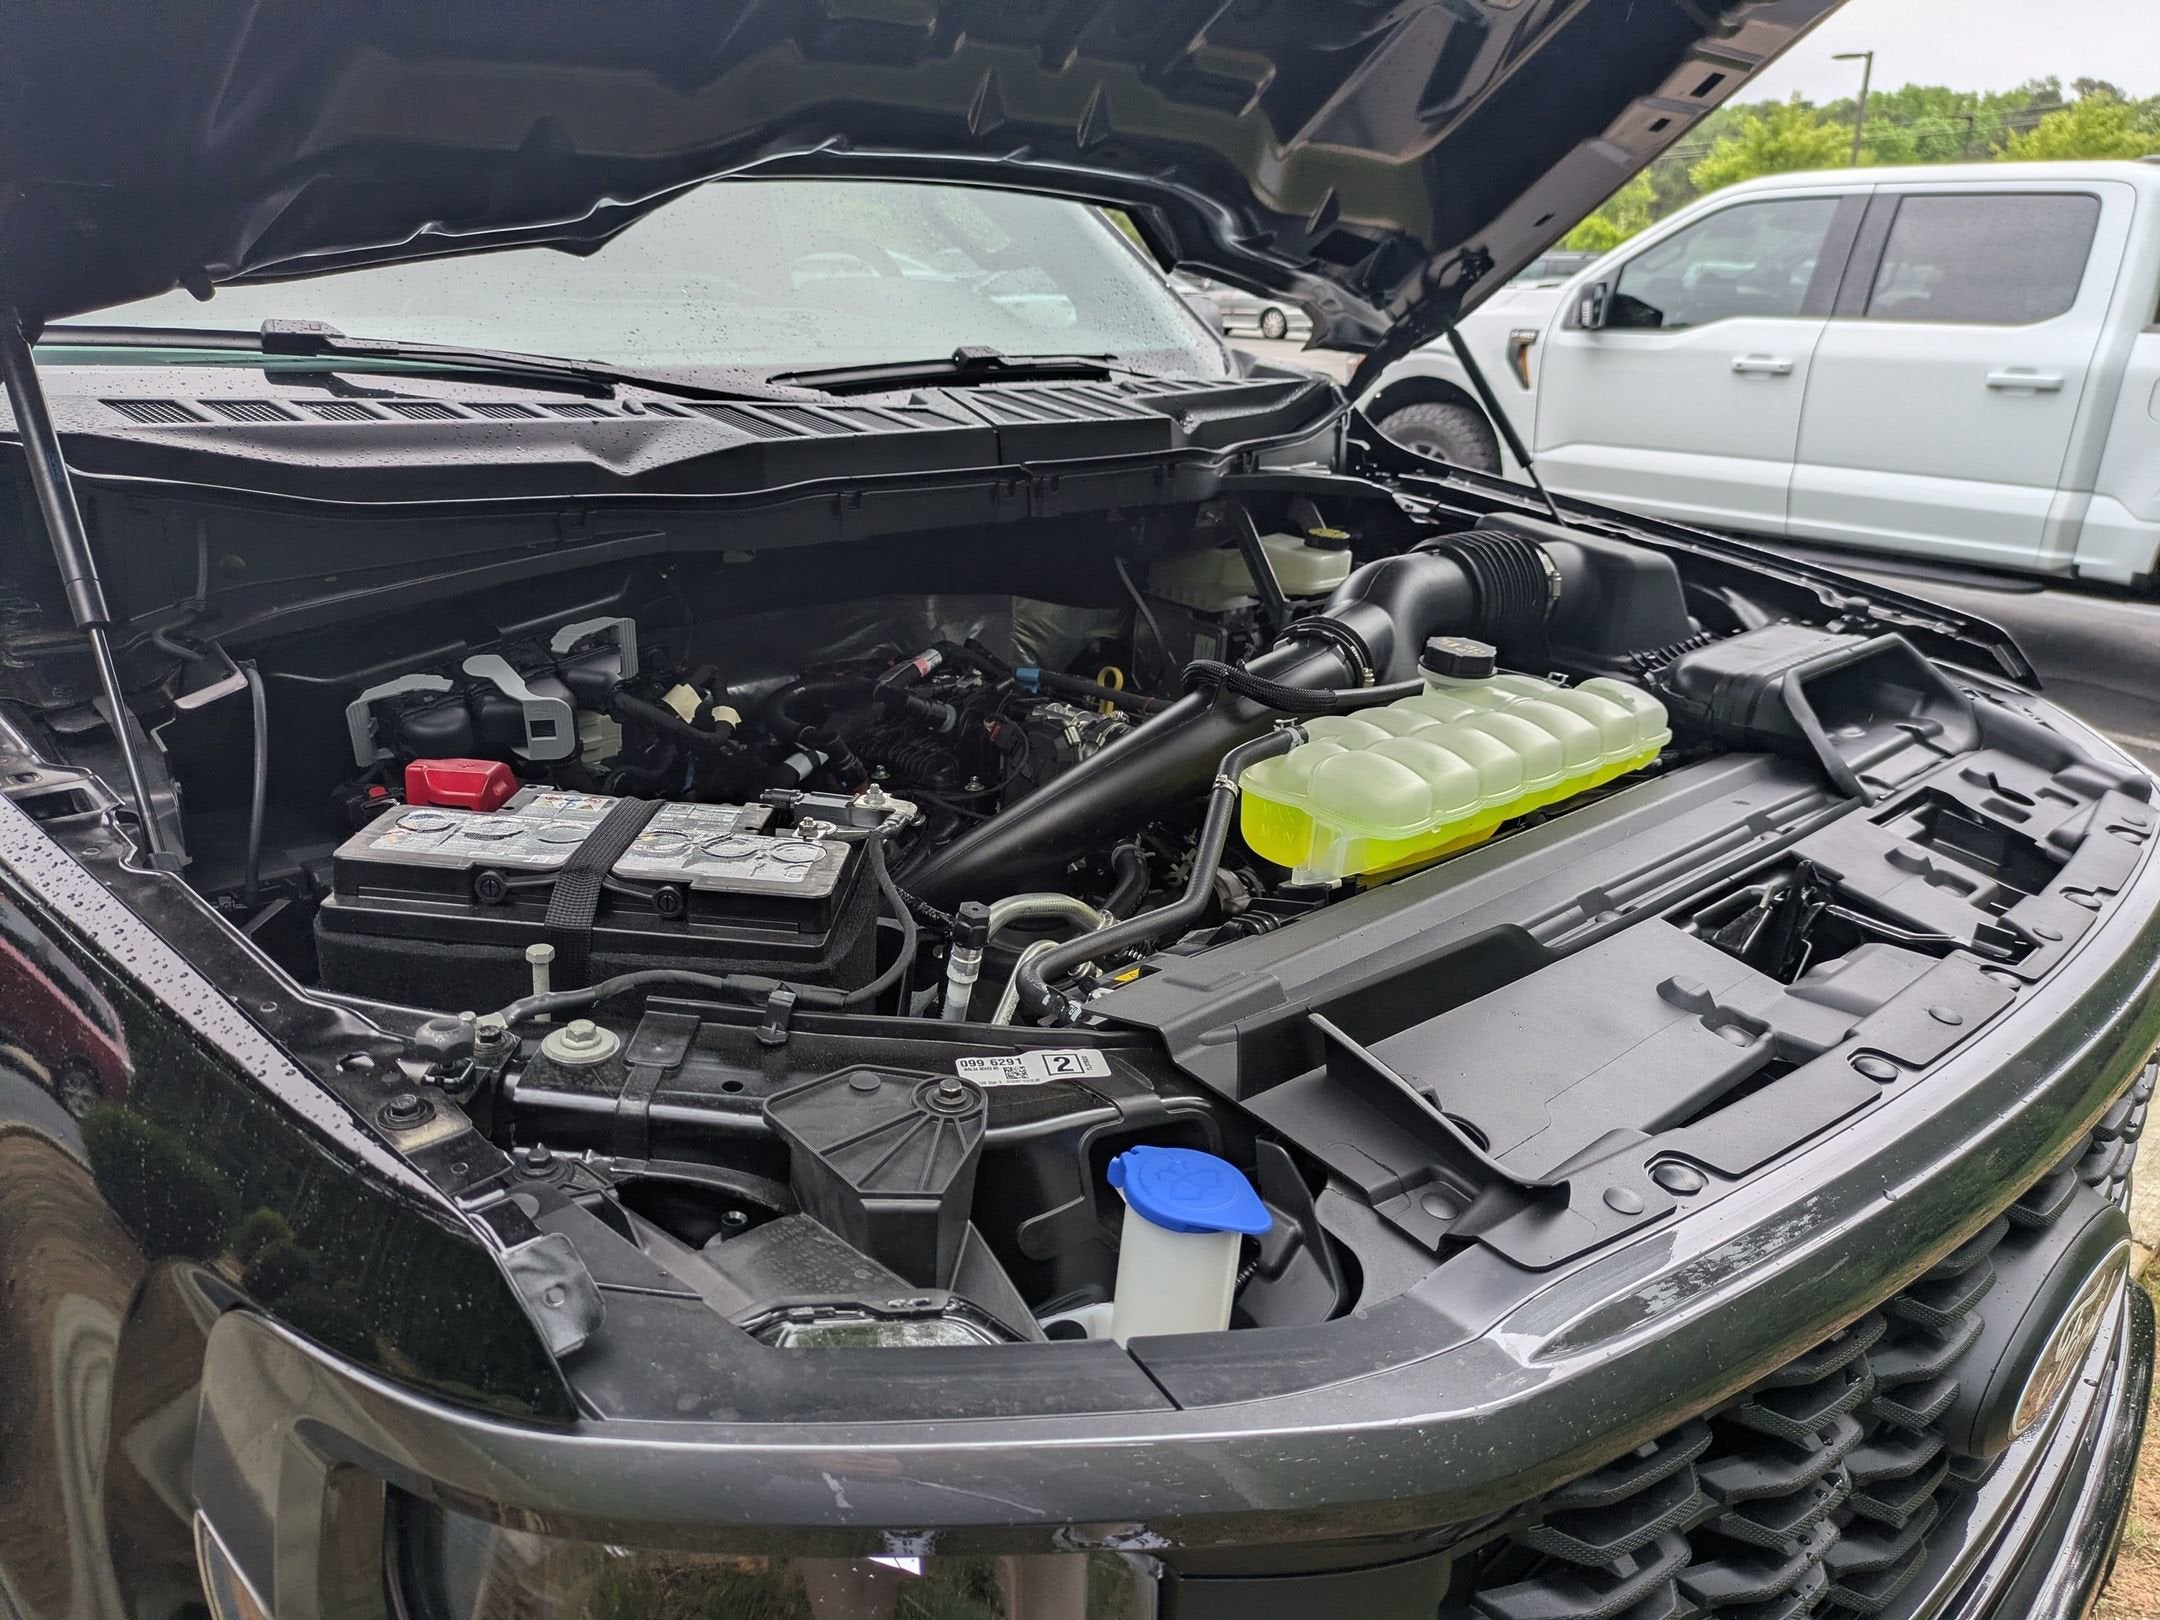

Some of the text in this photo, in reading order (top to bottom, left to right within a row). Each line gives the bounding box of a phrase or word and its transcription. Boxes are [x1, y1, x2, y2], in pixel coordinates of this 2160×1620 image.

[959, 1057, 1023, 1068] 099 6291
[1053, 1056, 1074, 1073] 2
